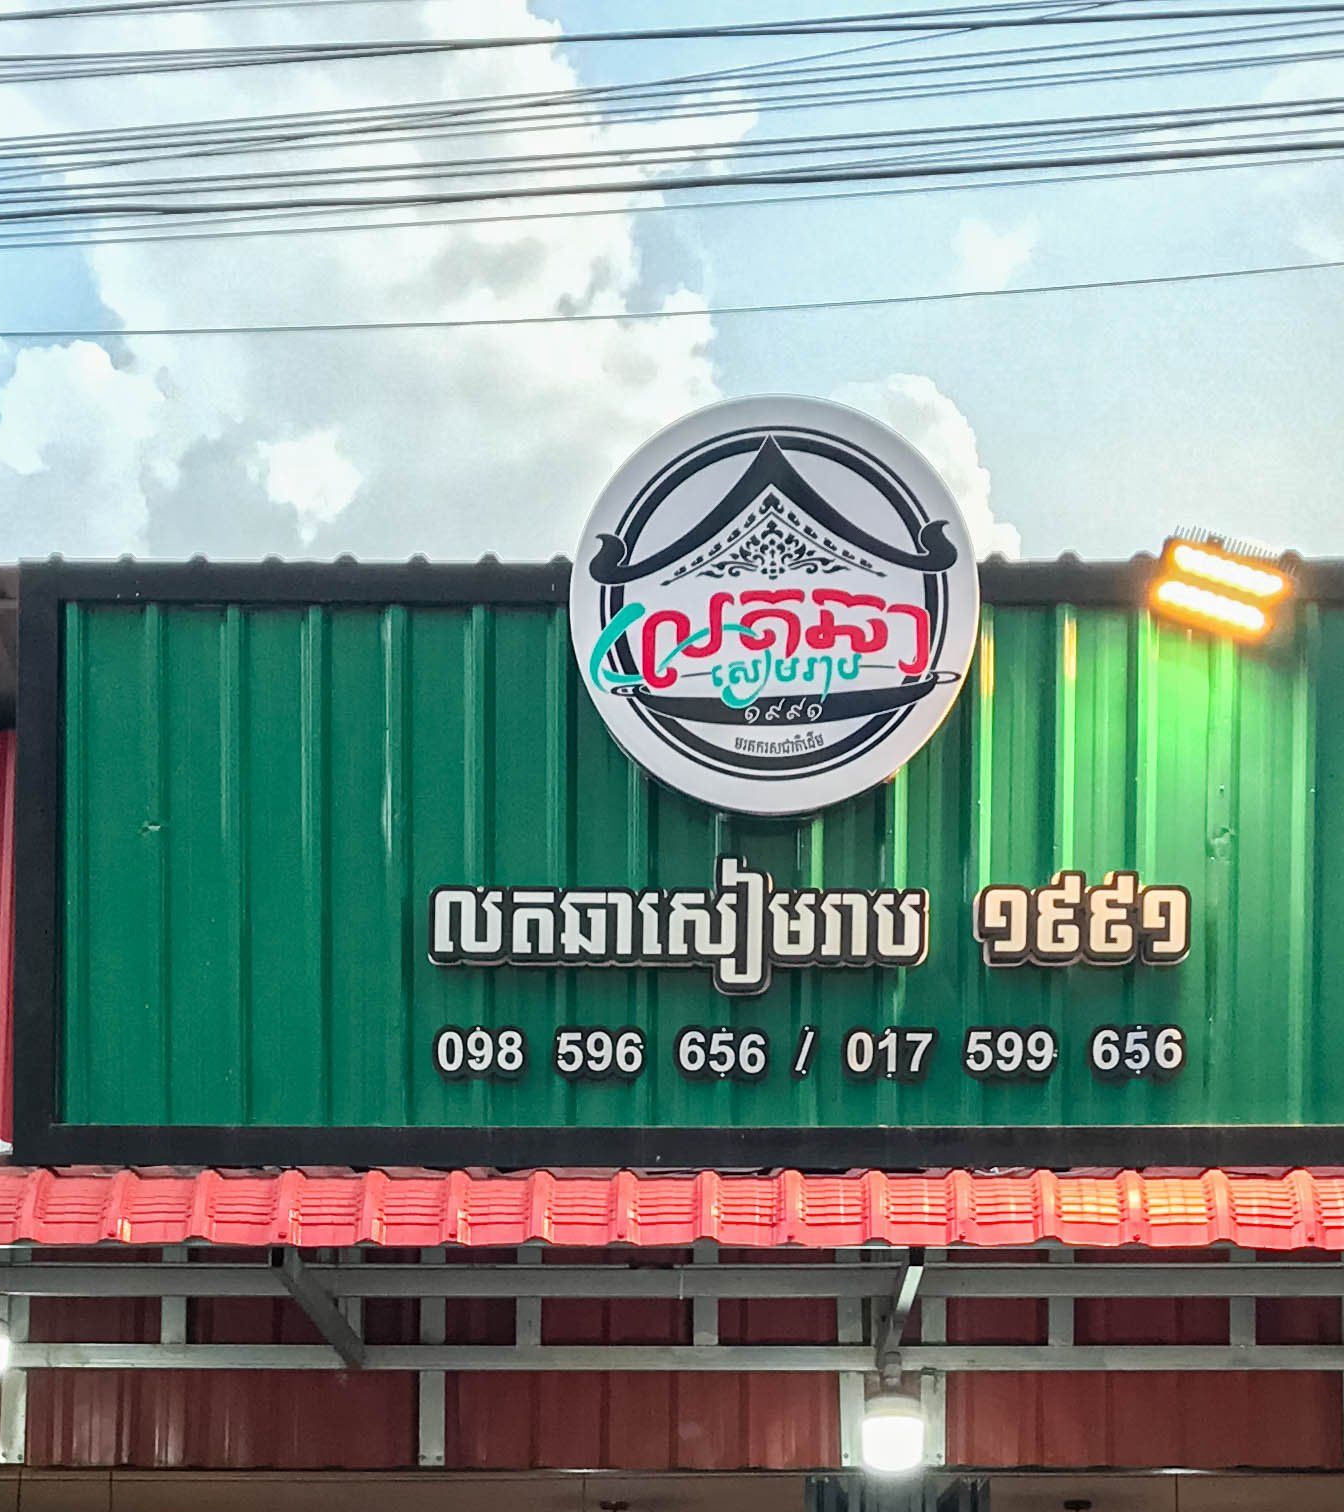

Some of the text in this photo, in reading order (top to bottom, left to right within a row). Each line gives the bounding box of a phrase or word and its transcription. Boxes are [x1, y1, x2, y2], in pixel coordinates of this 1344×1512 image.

[744, 697, 823, 724] ១៩៩១
[982, 873, 1190, 956] ១៩៩១
[436, 1031, 524, 1072] 098
[557, 1031, 644, 1072] 596
[678, 1031, 766, 1074] 656
[846, 1031, 934, 1073] 017
[965, 1031, 1055, 1072] 599
[1091, 1030, 1183, 1071] 656
